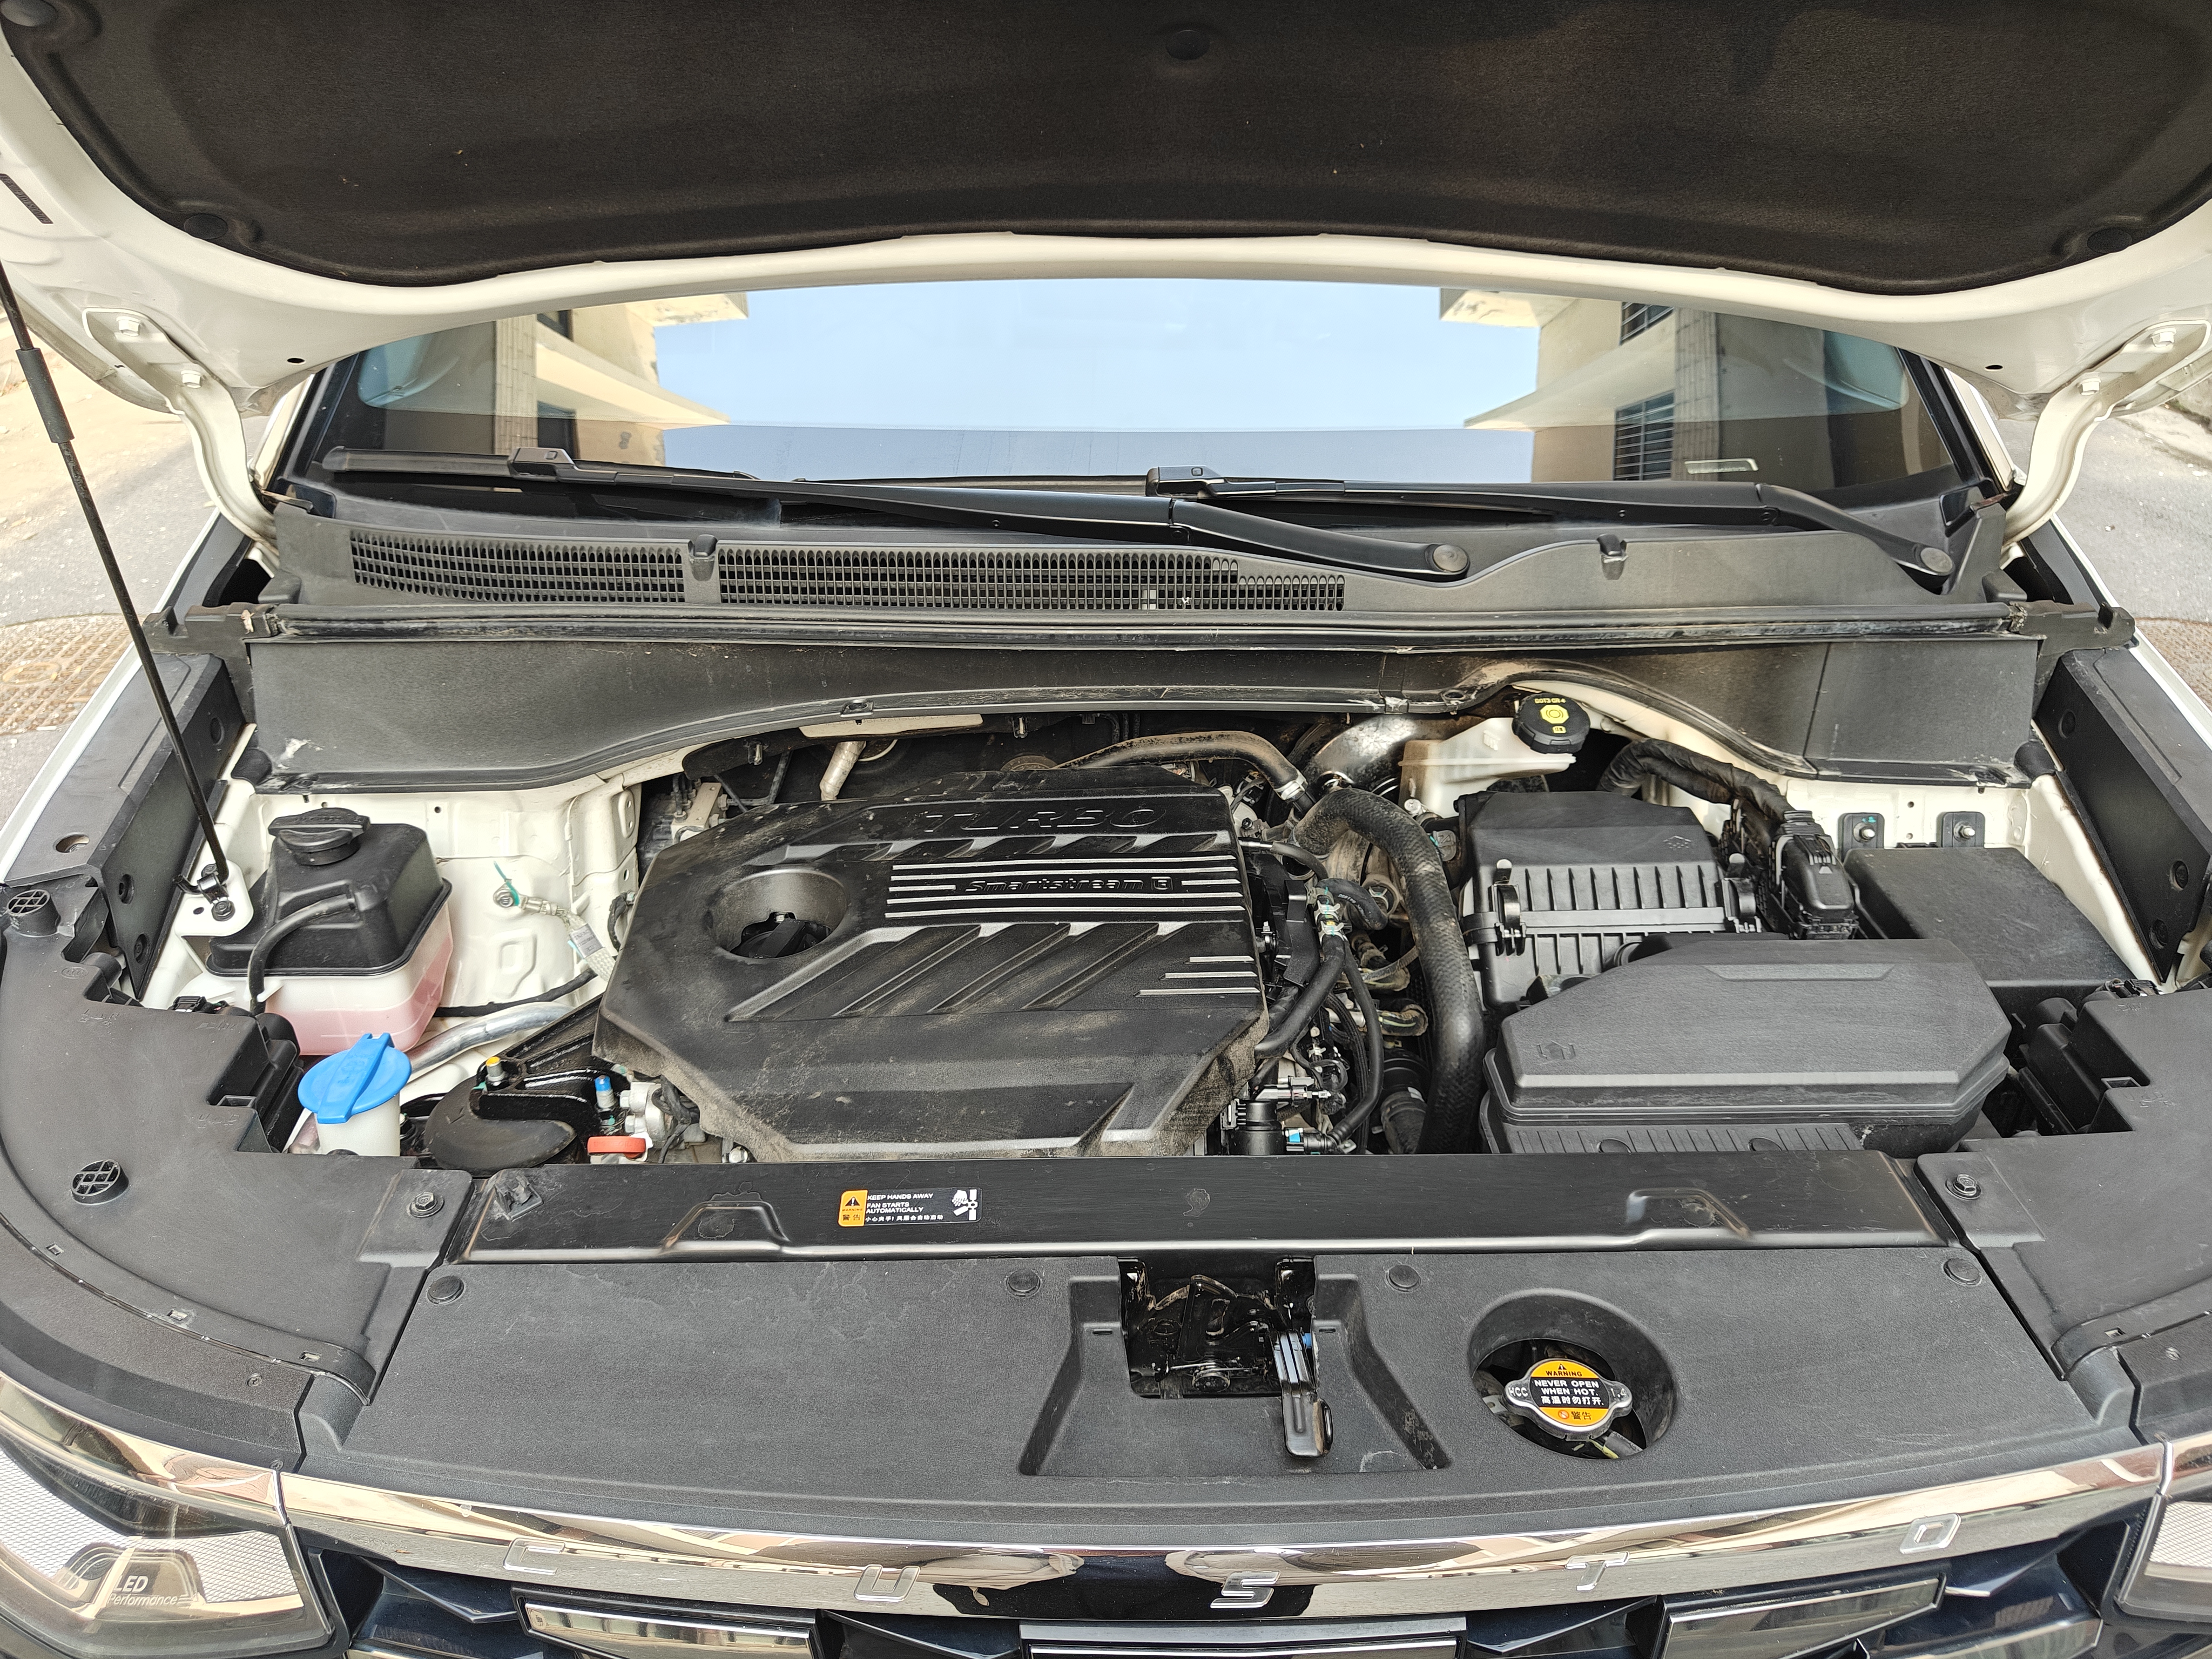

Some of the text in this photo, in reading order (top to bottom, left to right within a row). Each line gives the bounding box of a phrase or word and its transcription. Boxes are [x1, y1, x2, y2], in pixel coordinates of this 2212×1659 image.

[965, 877, 1144, 892] Smartstream
[1534, 1379, 1600, 1388] NEVER OPEN
[1508, 1386, 1528, 1398] HCC
[1571, 1411, 1592, 1420] 警告
[113, 1575, 149, 1592] LED
[108, 1593, 179, 1606] Performance
